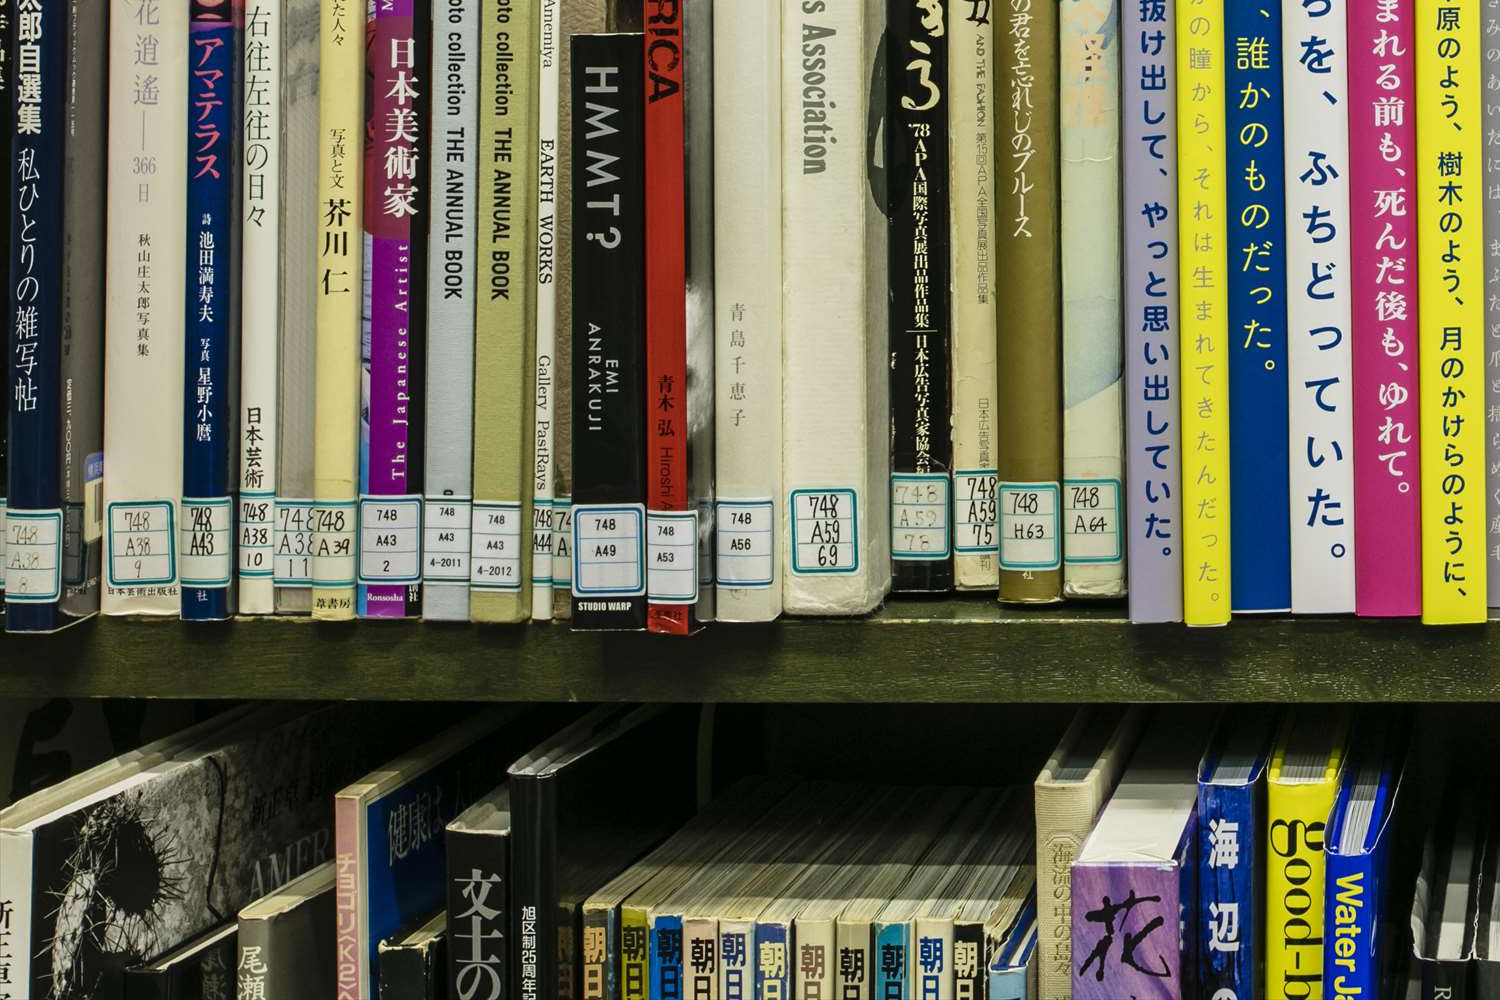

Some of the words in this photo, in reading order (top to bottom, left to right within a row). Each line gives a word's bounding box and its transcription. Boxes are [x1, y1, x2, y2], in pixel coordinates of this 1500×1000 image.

[194, 37, 225, 180] アマテラス
[447, 32, 465, 116] collection
[802, 24, 837, 175] Association
[245, 4, 272, 228] 右往左往の日々
[383, 36, 420, 217] 日本美術家
[447, 127, 464, 162] THE
[540, 139, 555, 203] EARTH
[321, 198, 351, 256] 芥川
[445, 169, 464, 245] ANNUAL
[15, 147, 40, 412] 私ひとりの雑写帖
[321, 269, 350, 295] 仁
[394, 244, 408, 312] Artist
[444, 251, 463, 300] BOOK
[539, 215, 553, 285] WORKS
[136, 234, 151, 356] 秋山庄太郎写真集
[391, 327, 408, 429] Japanese
[537, 356, 550, 410] Gallery
[588, 322, 602, 432] ANRAKUJI
[605, 359, 619, 394] EMI
[729, 303, 746, 427] 青島千恵子
[391, 442, 407, 479] The
[537, 420, 551, 491] PastRays
[595, 518, 616, 531] 748
[595, 545, 617, 559] A49
[578, 602, 604, 611] STUDIO
[605, 602, 632, 612] WARP
[1335, 872, 1364, 972] Water
